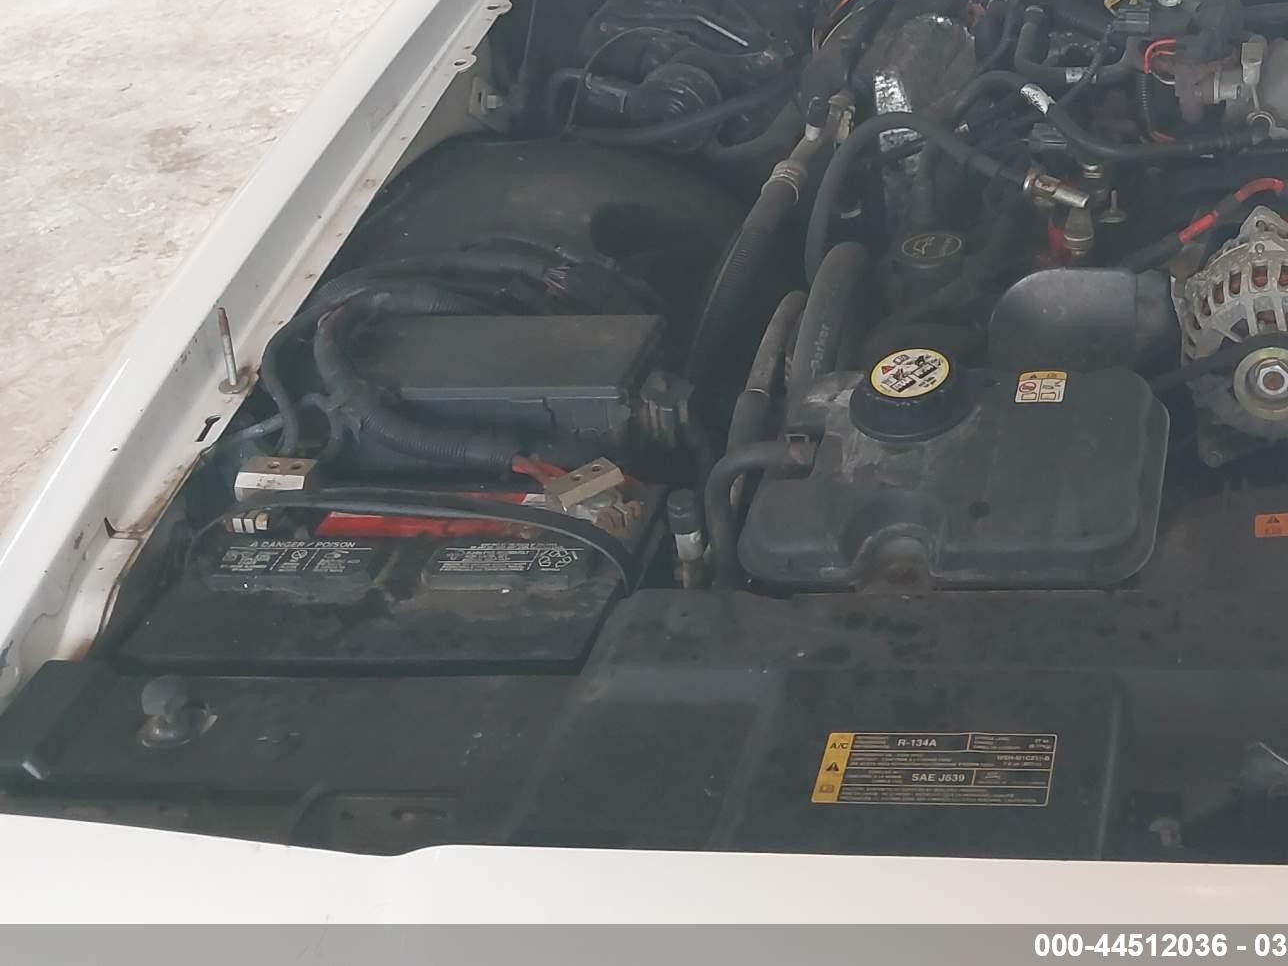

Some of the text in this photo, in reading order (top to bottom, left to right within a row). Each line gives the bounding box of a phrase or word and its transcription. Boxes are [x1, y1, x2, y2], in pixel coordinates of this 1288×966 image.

[897, 738, 937, 747] R-134A
[912, 774, 936, 782] SAE
[938, 774, 966, 782] J639
